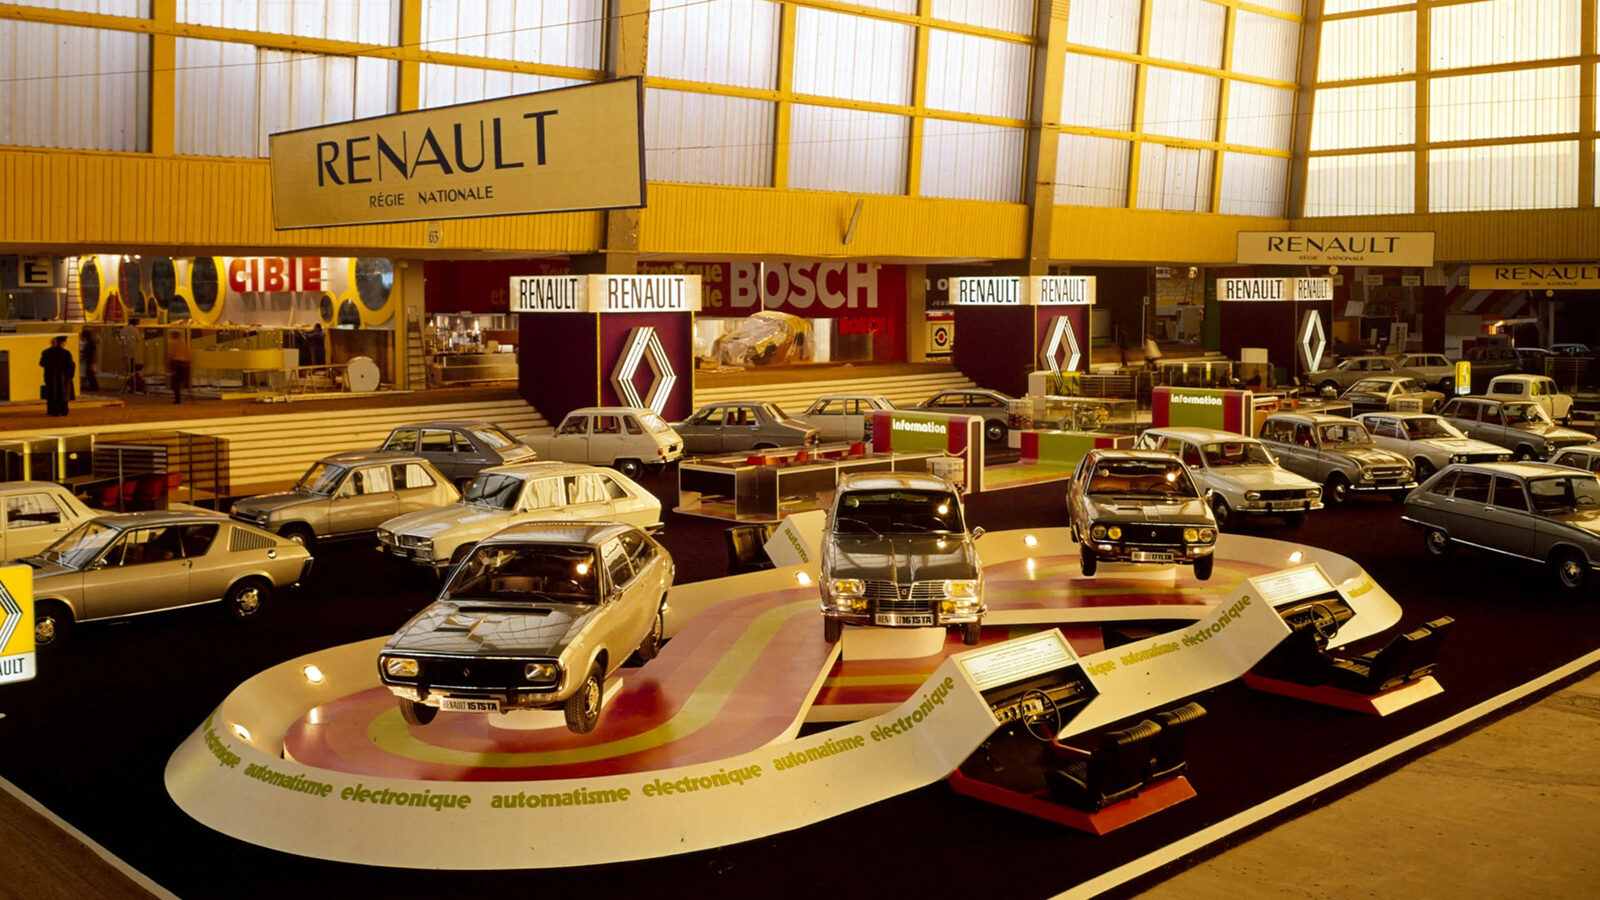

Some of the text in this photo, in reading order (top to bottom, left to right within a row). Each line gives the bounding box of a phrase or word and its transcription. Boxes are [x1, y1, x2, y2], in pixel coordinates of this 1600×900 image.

[316, 109, 558, 187] RENAULT
[369, 185, 494, 208] RÉGIE NATIONALE
[1267, 236, 1401, 254] RENAULT
[729, 262, 879, 309] BOSCH
[1495, 267, 1600, 280] RENAULT
[520, 279, 577, 309] RENAULT
[608, 278, 684, 309] RENAULT
[959, 279, 1019, 303] RENAULT
[1041, 279, 1086, 303] RENAULT
[1226, 280, 1283, 300] RENAULT
[1298, 279, 1329, 299] RENAULT
[1181, 593, 1252, 650] electronique
[443, 700, 466, 710] RENAULT
[243, 761, 333, 798] automatisme
[340, 783, 471, 811] electronique
[490, 784, 631, 809] automatisme
[643, 762, 763, 798] electronique
[773, 733, 865, 772] automatisme
[870, 674, 955, 743] electronique
